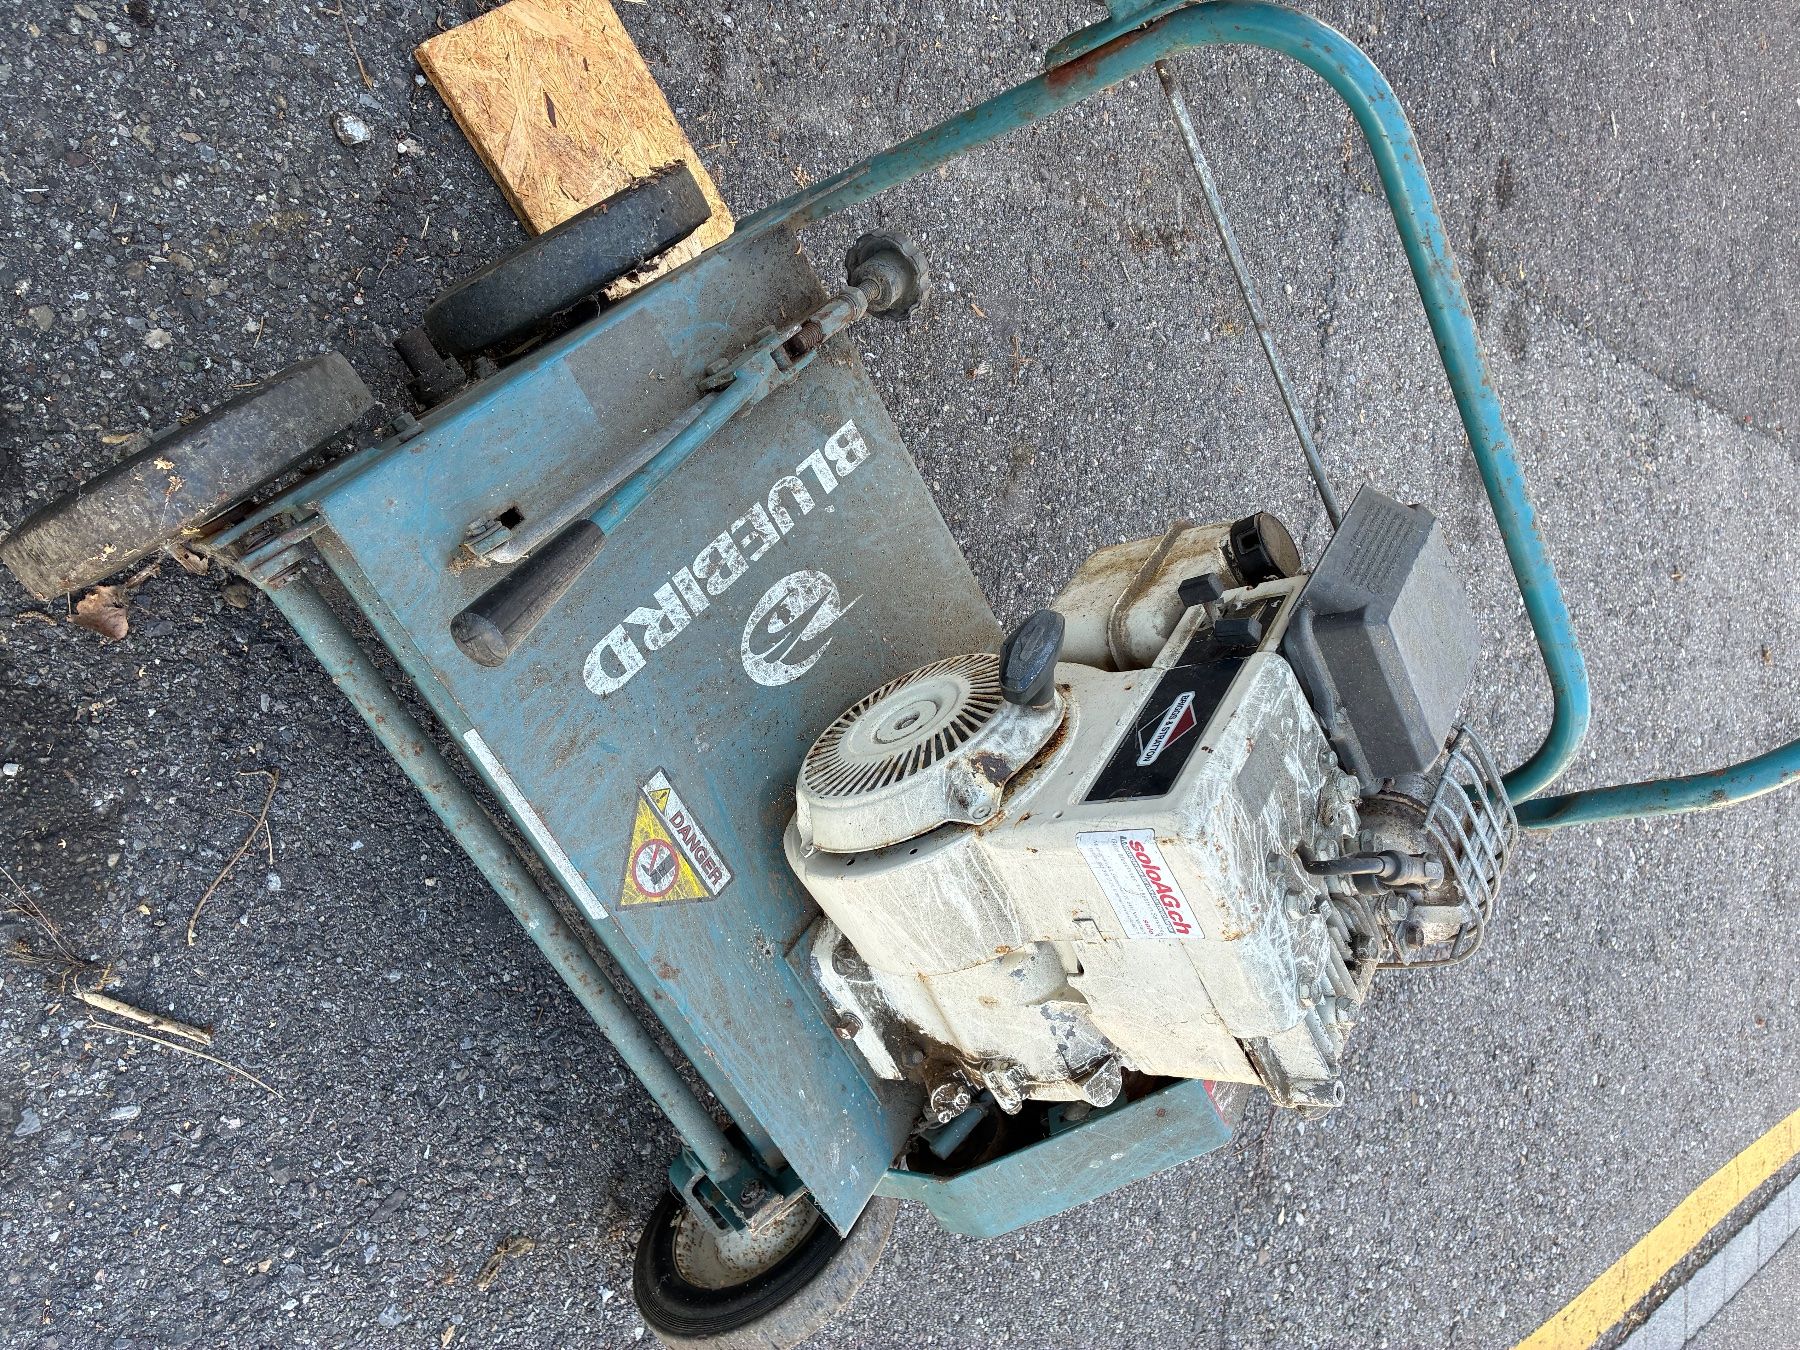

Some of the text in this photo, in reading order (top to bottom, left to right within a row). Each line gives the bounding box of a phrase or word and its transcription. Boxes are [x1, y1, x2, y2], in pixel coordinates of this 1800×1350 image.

[583, 419, 870, 695] BLUEBIRD
[1142, 725, 1171, 762] STRATTON
[1168, 695, 1190, 720] BRIGGS
[669, 811, 724, 888] DANGER
[1129, 840, 1191, 934] soloAG.ch
